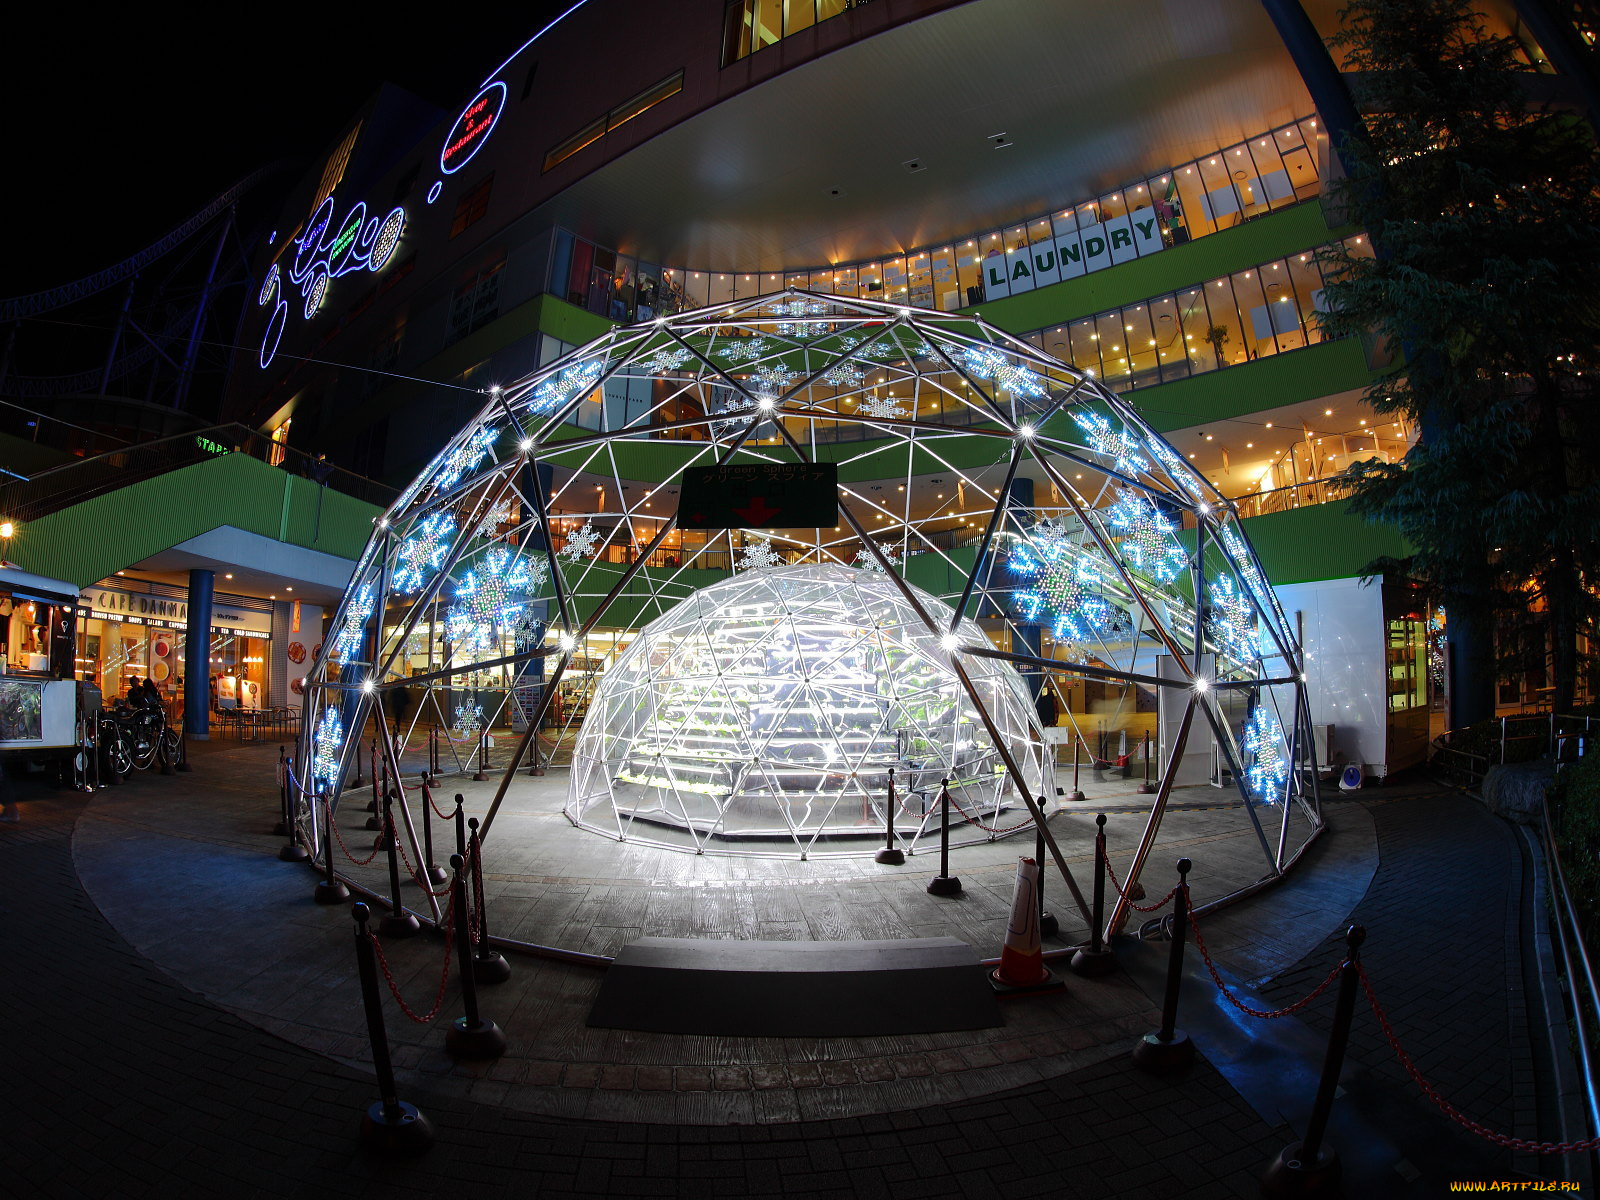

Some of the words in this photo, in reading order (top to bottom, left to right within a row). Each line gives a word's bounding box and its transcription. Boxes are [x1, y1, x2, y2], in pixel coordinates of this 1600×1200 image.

[463, 98, 488, 122] Shop
[443, 113, 493, 161] Restaurant
[989, 218, 1155, 286] LAUNDRY
[128, 616, 142, 624] SOUPS
[147, 619, 163, 627] SALADS
